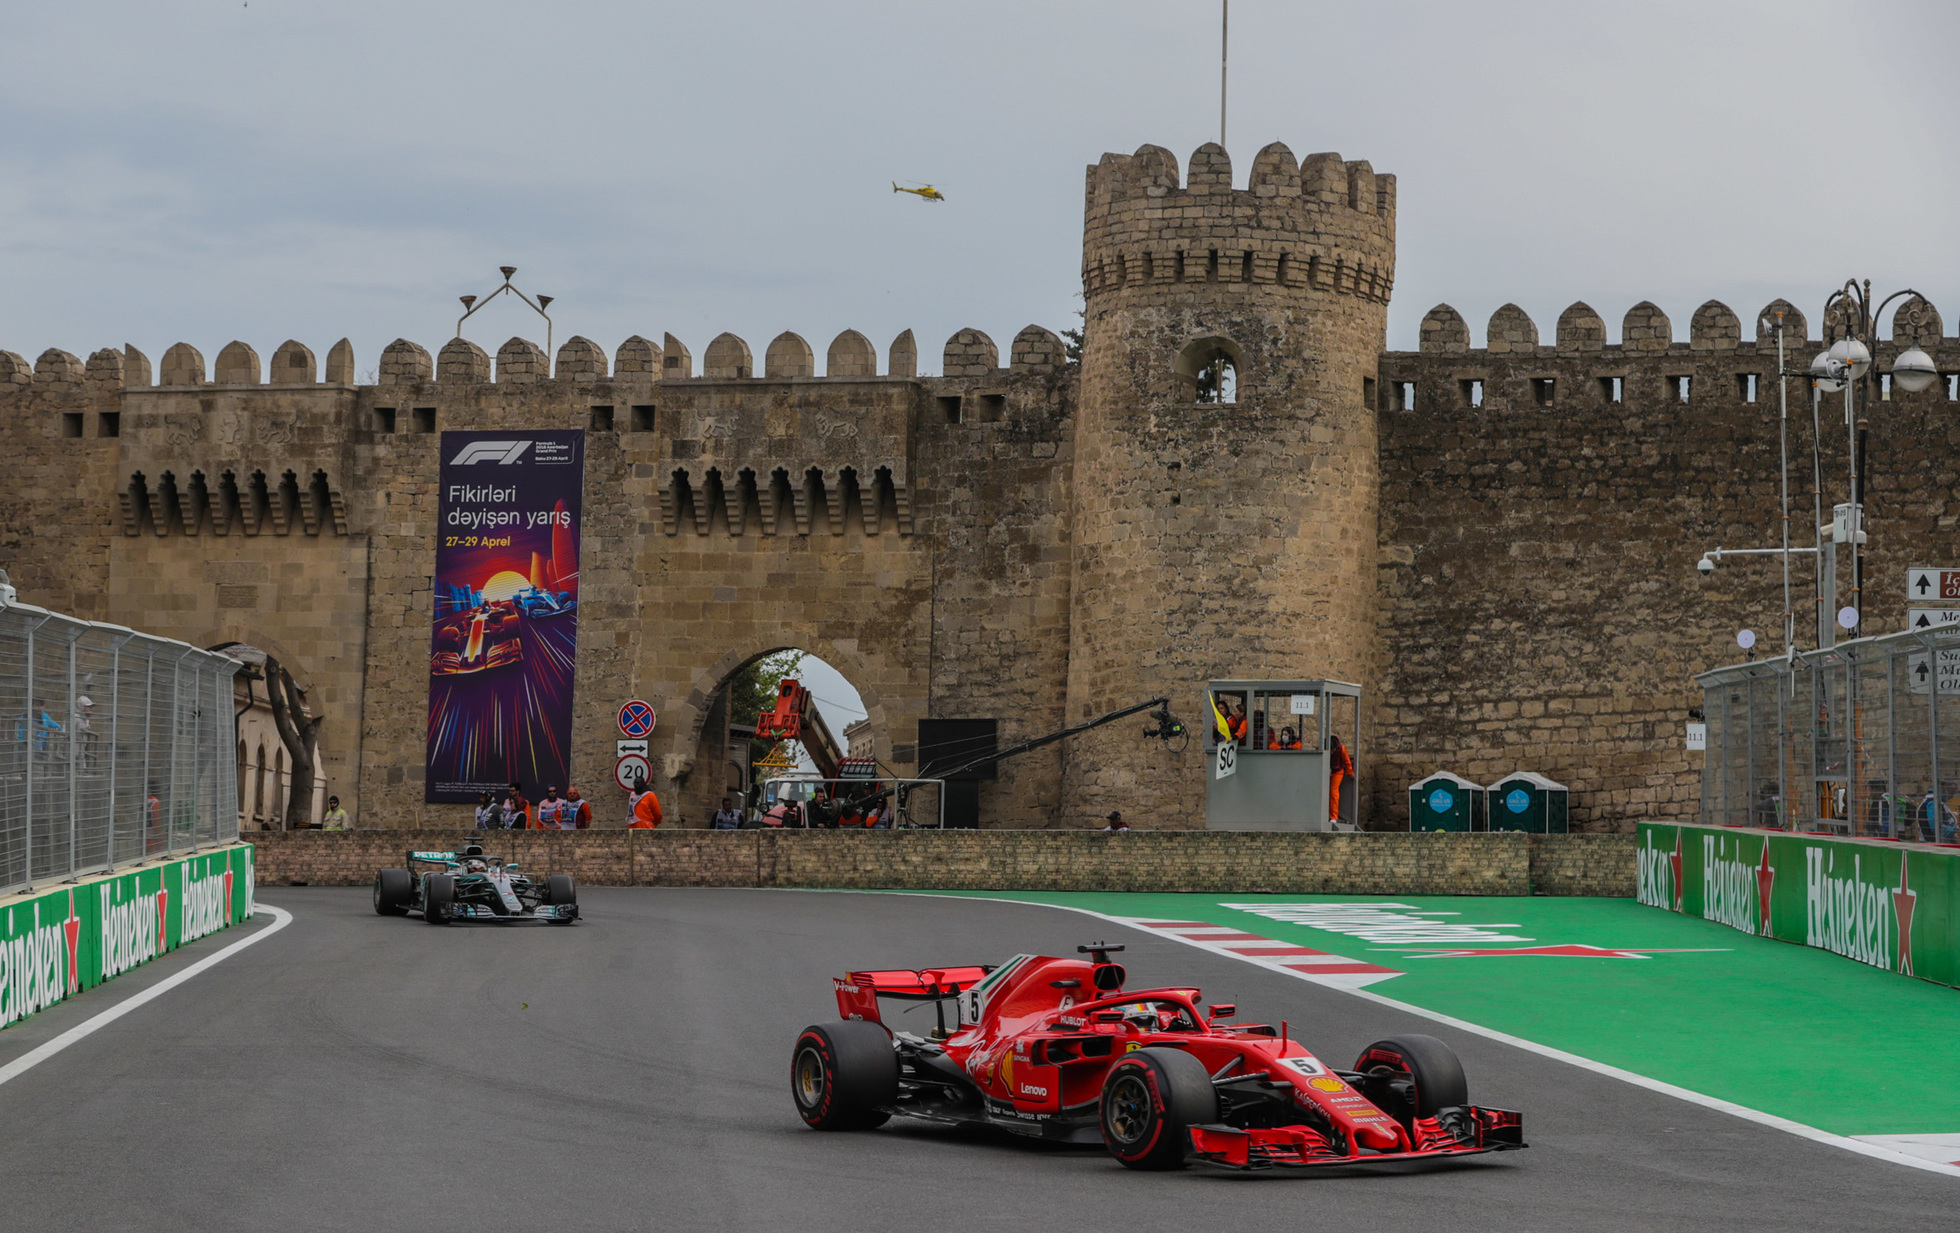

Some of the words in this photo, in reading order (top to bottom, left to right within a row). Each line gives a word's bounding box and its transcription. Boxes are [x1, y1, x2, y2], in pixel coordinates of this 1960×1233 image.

[449, 484, 516, 502] Fikirləri
[447, 507, 520, 530] dəyişən
[526, 511, 571, 530] yarış
[480, 536, 511, 549] Aprel
[1688, 733, 1703, 741] 11.1
[1219, 744, 1235, 771] SC
[623, 764, 644, 779] 20
[1703, 835, 1755, 935] Heineken
[181, 858, 224, 943] Heineken
[1806, 847, 1891, 970] Heineken
[100, 876, 156, 978] Heineken
[833, 980, 860, 994] V-Power
[971, 992, 979, 1023] 5
[1060, 1015, 1087, 1027] HUBLOT
[1289, 1059, 1318, 1074] 5
[1021, 1082, 1047, 1097] Lenovo
